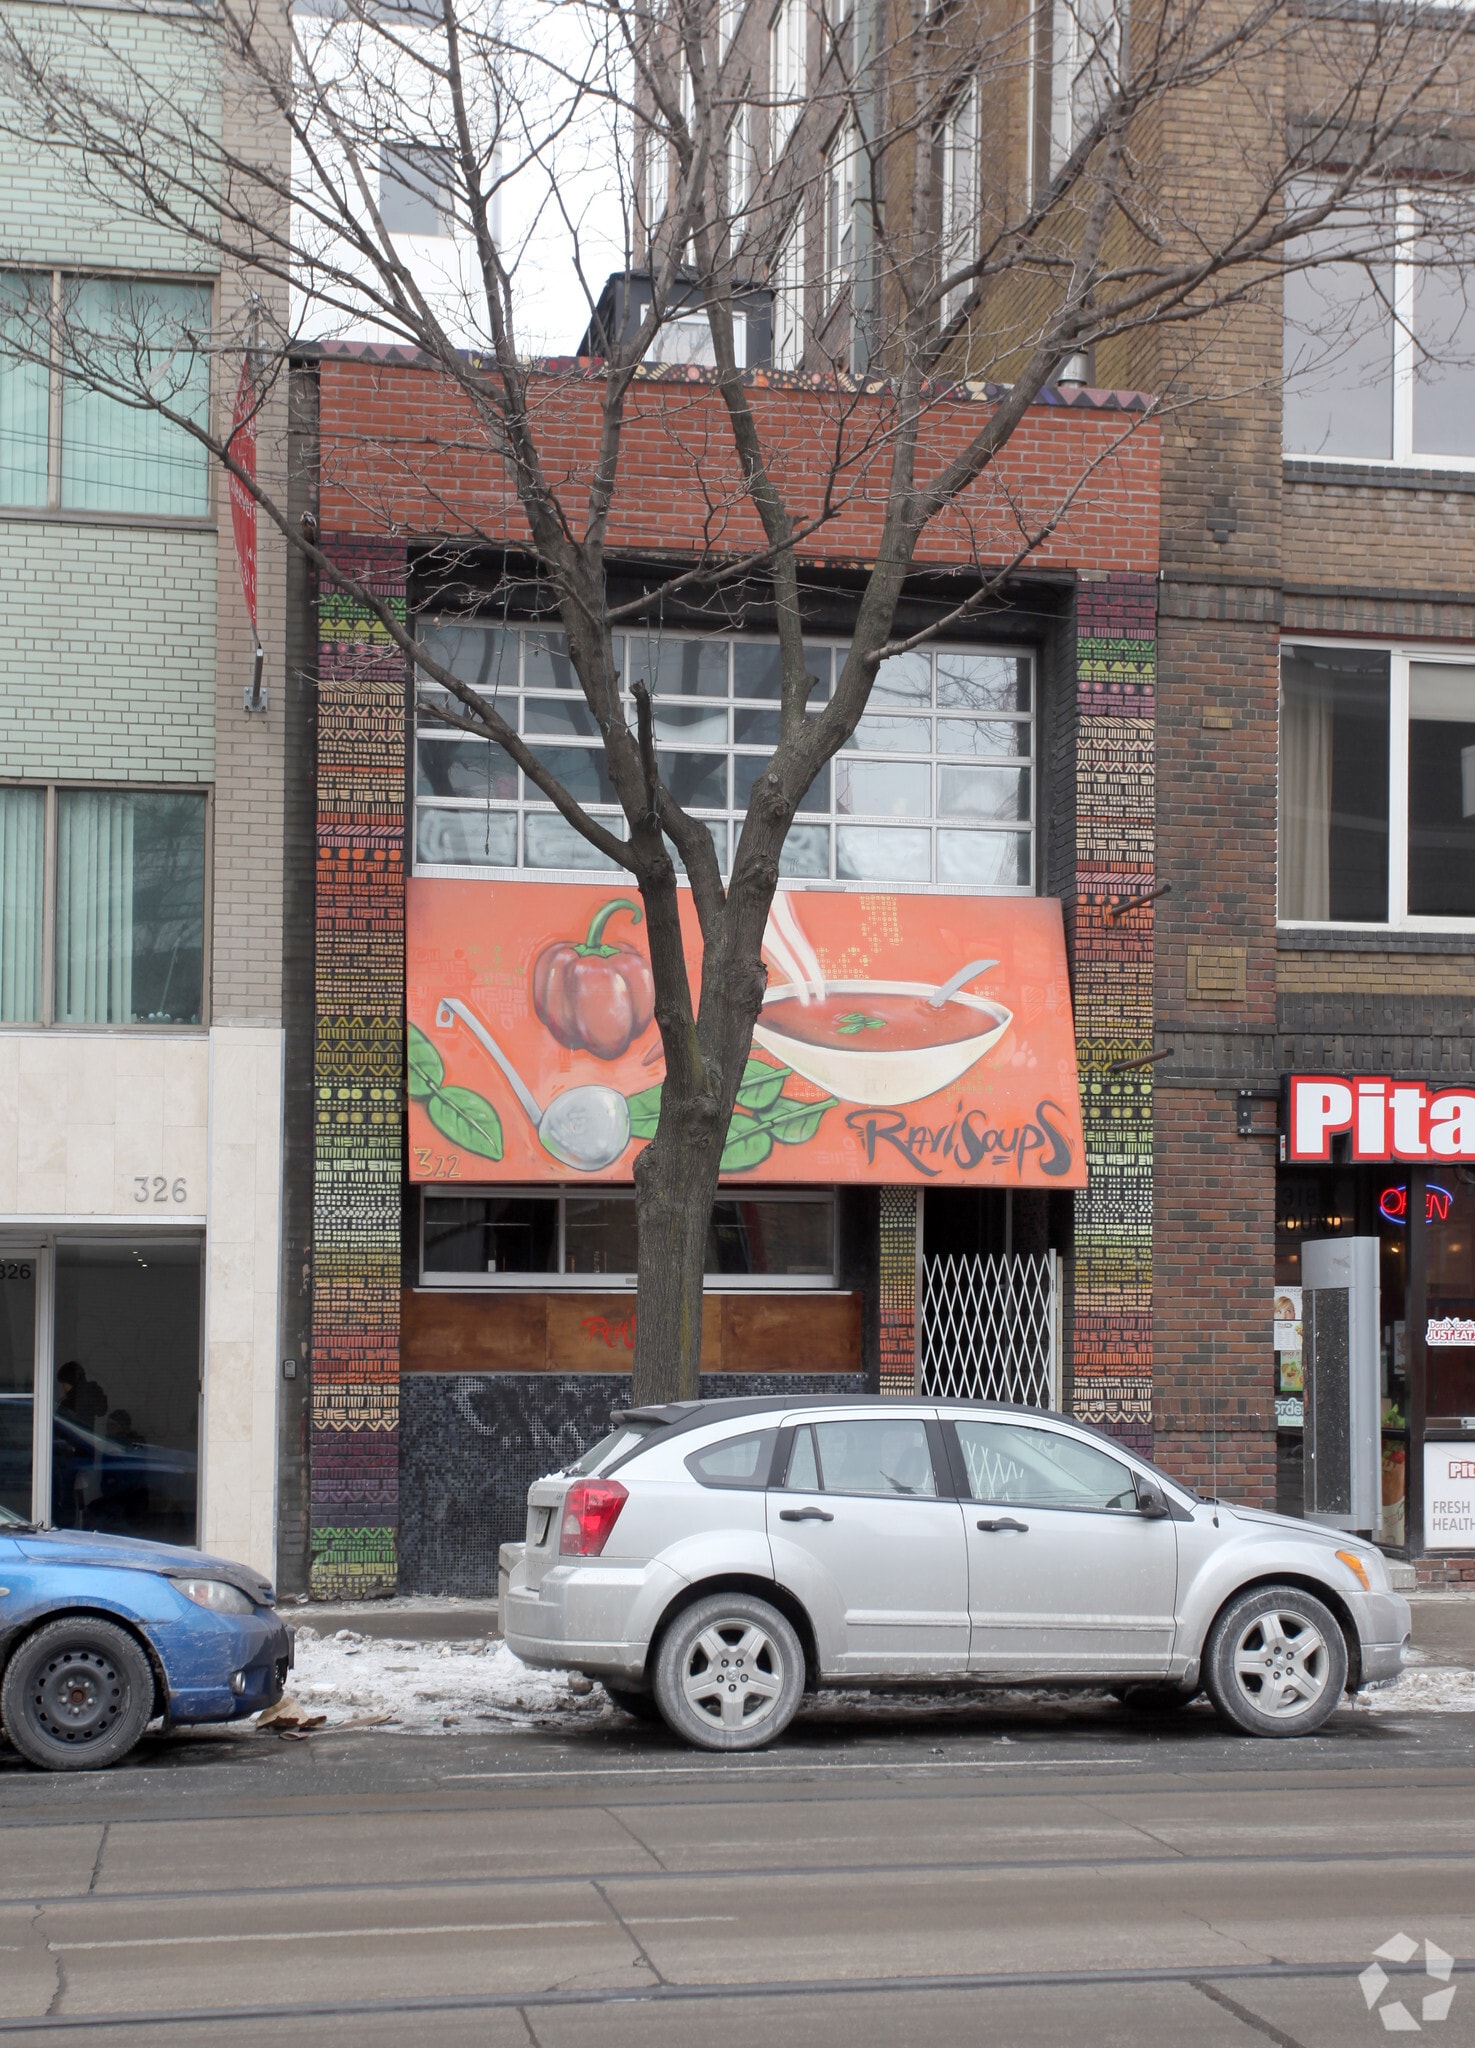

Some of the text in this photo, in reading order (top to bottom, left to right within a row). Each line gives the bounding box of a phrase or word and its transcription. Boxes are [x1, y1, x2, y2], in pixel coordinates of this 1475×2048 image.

[1296, 1082, 1475, 1155] Pita
[413, 1146, 461, 1178] 322
[134, 1176, 187, 1203] 326
[1380, 1188, 1449, 1219] ON
[1275, 1401, 1304, 1415] orde
[1433, 1501, 1470, 1513] FRESH
